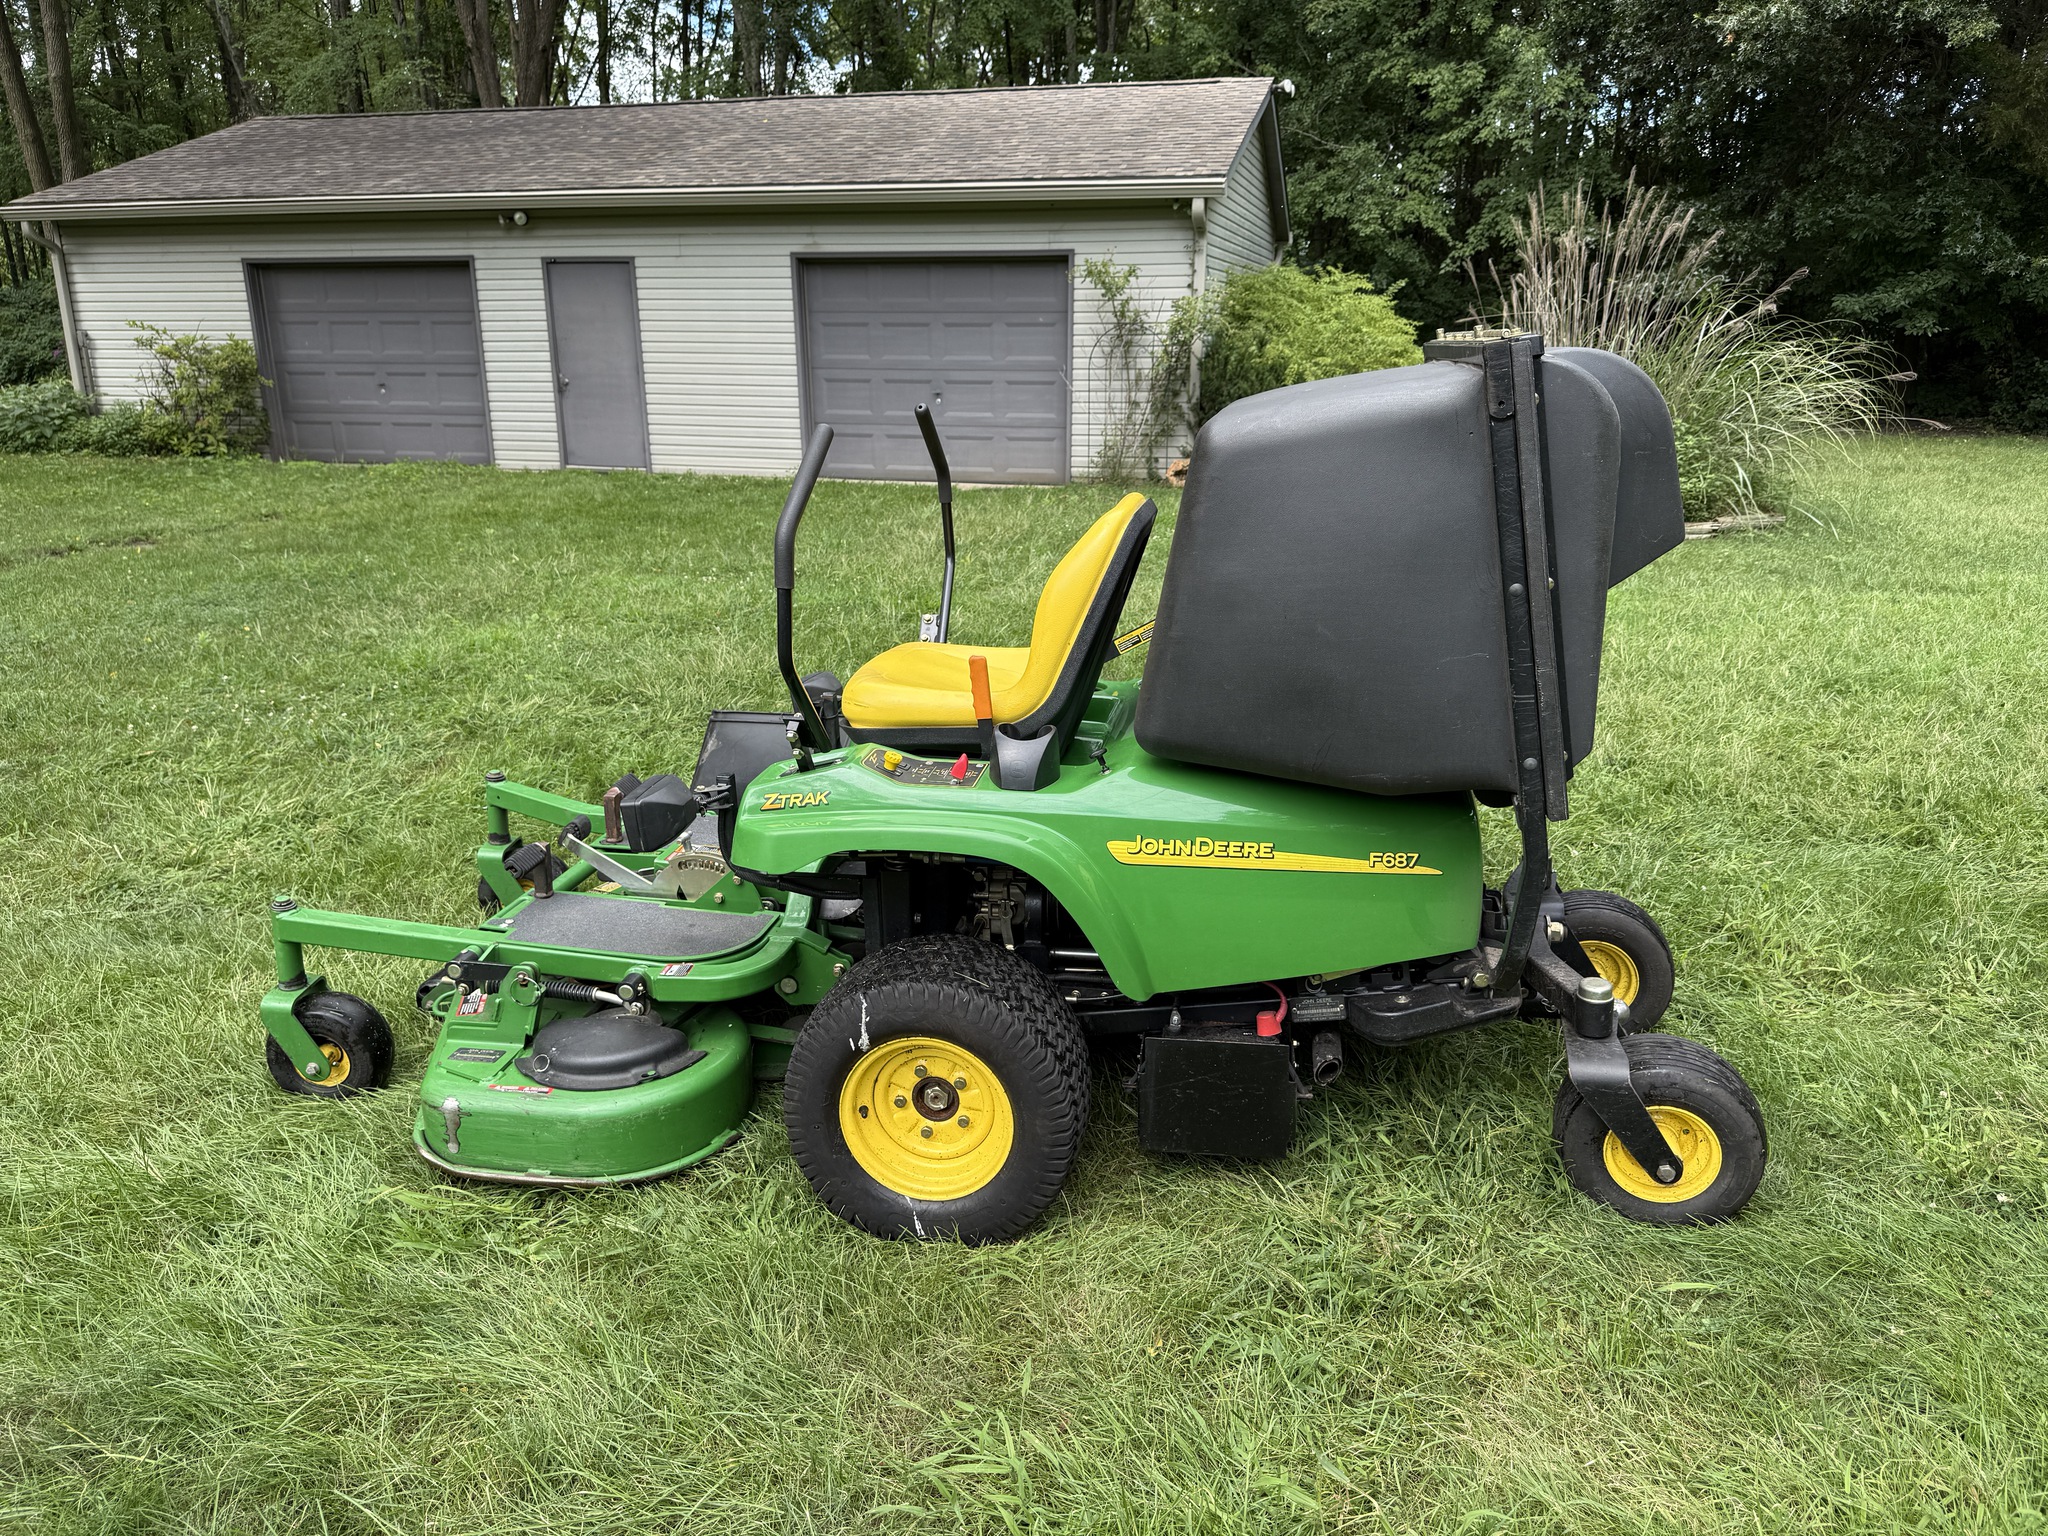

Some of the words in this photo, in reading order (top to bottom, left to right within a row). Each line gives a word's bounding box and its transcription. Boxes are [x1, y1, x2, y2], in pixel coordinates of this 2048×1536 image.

[760, 790, 831, 811] ZTRAK
[1127, 834, 1192, 856] JOHN
[1195, 836, 1274, 859] DEERE
[1369, 851, 1420, 868] F687
